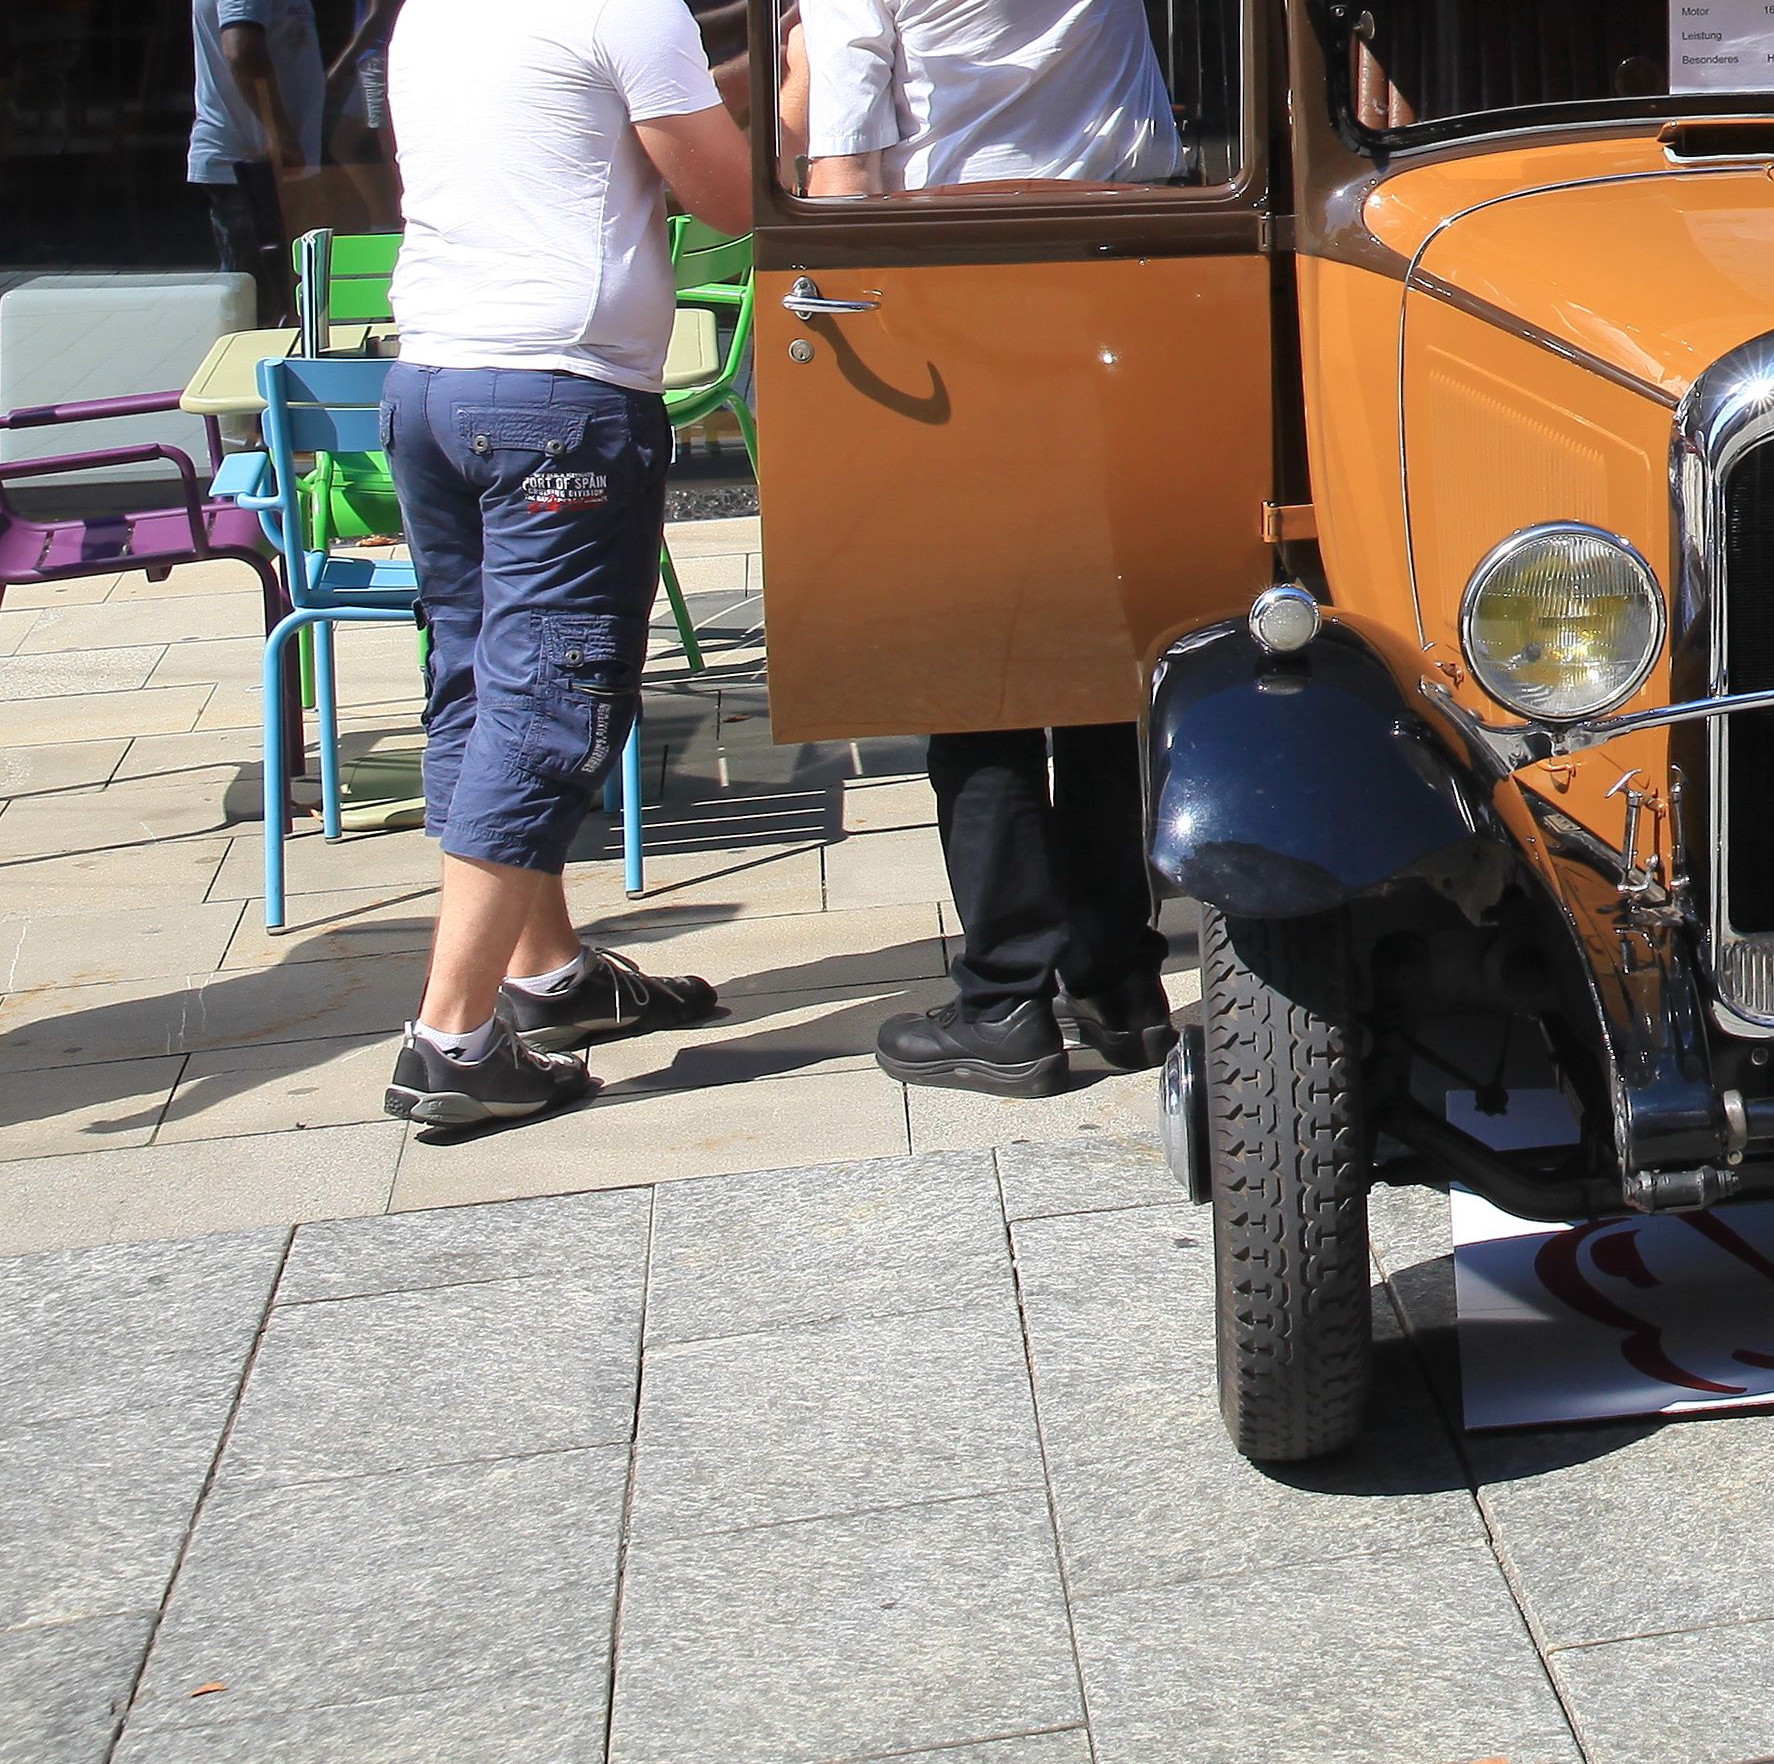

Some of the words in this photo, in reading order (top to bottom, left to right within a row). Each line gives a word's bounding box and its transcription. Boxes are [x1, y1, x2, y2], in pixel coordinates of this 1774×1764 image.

[1681, 7, 1709, 17] Motor
[1681, 30, 1723, 42] Leistung
[1682, 54, 1739, 65] Besonderes
[574, 475, 607, 490] SPAIN
